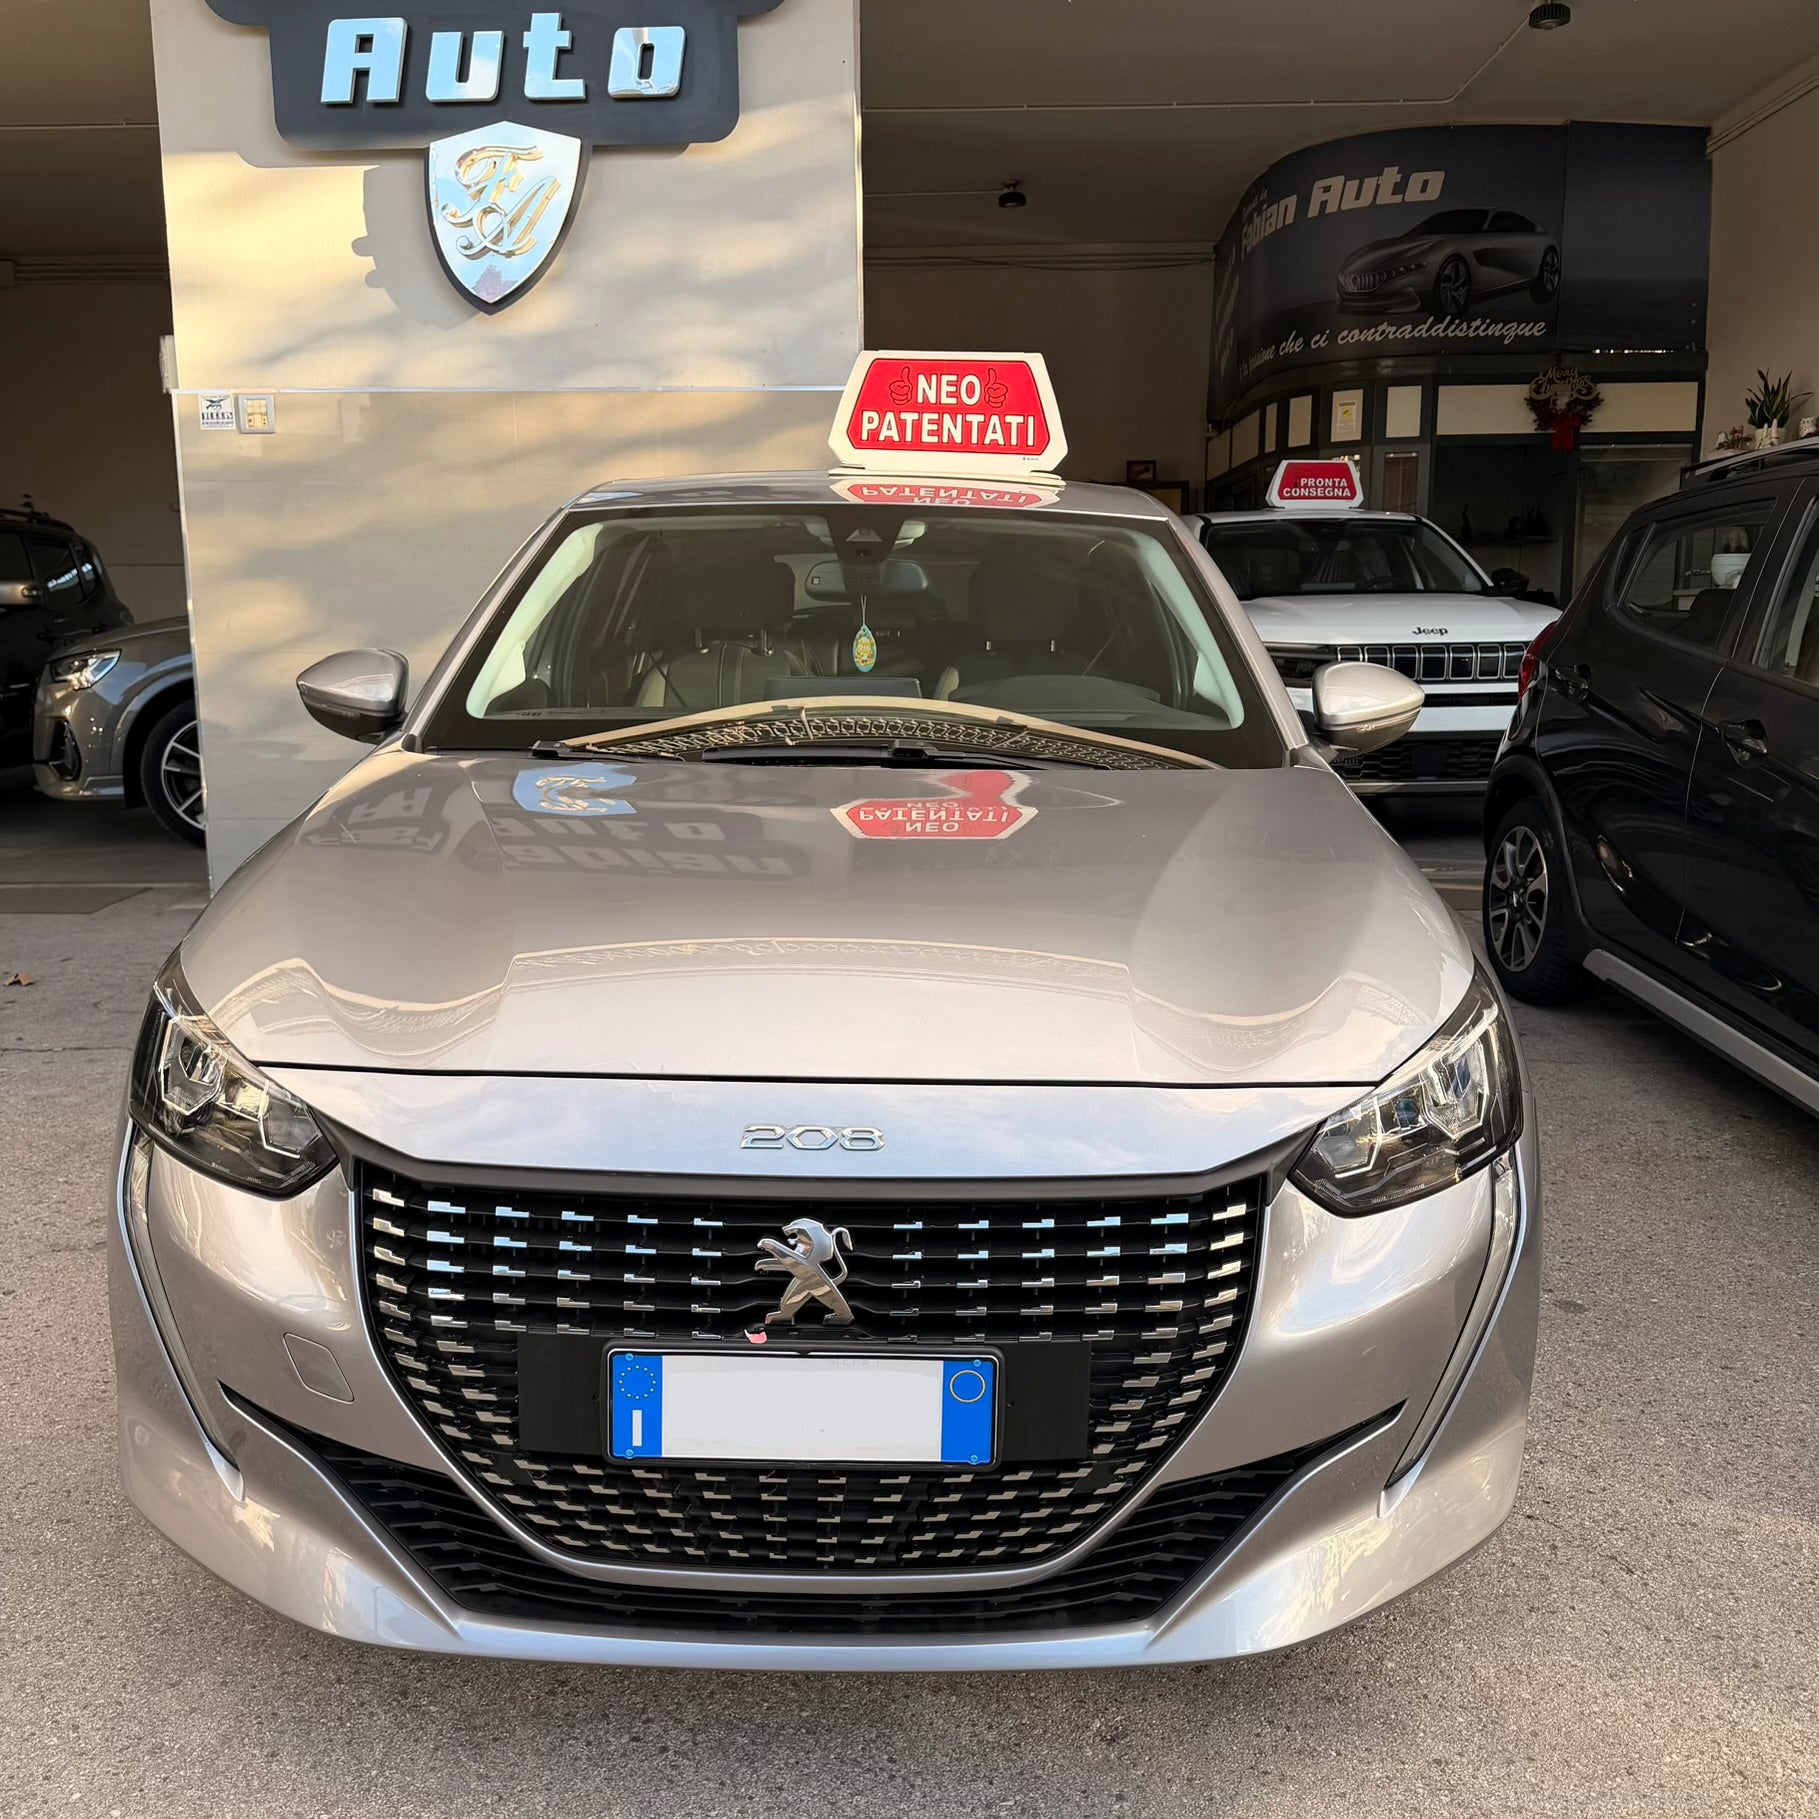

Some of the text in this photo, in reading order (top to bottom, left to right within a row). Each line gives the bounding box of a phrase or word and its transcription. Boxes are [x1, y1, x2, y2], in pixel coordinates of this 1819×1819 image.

[320, 12, 685, 104] Auto
[1307, 166, 1446, 219] Auto
[1279, 330, 1305, 356] che
[1310, 328, 1331, 349] ci
[917, 373, 981, 405] NEO
[860, 410, 1035, 448] PATENTATI
[1282, 487, 1351, 497] CONSEGNA
[1301, 477, 1348, 487] PRONTA
[1412, 627, 1448, 636] Jeep
[740, 1124, 885, 1151] 208
